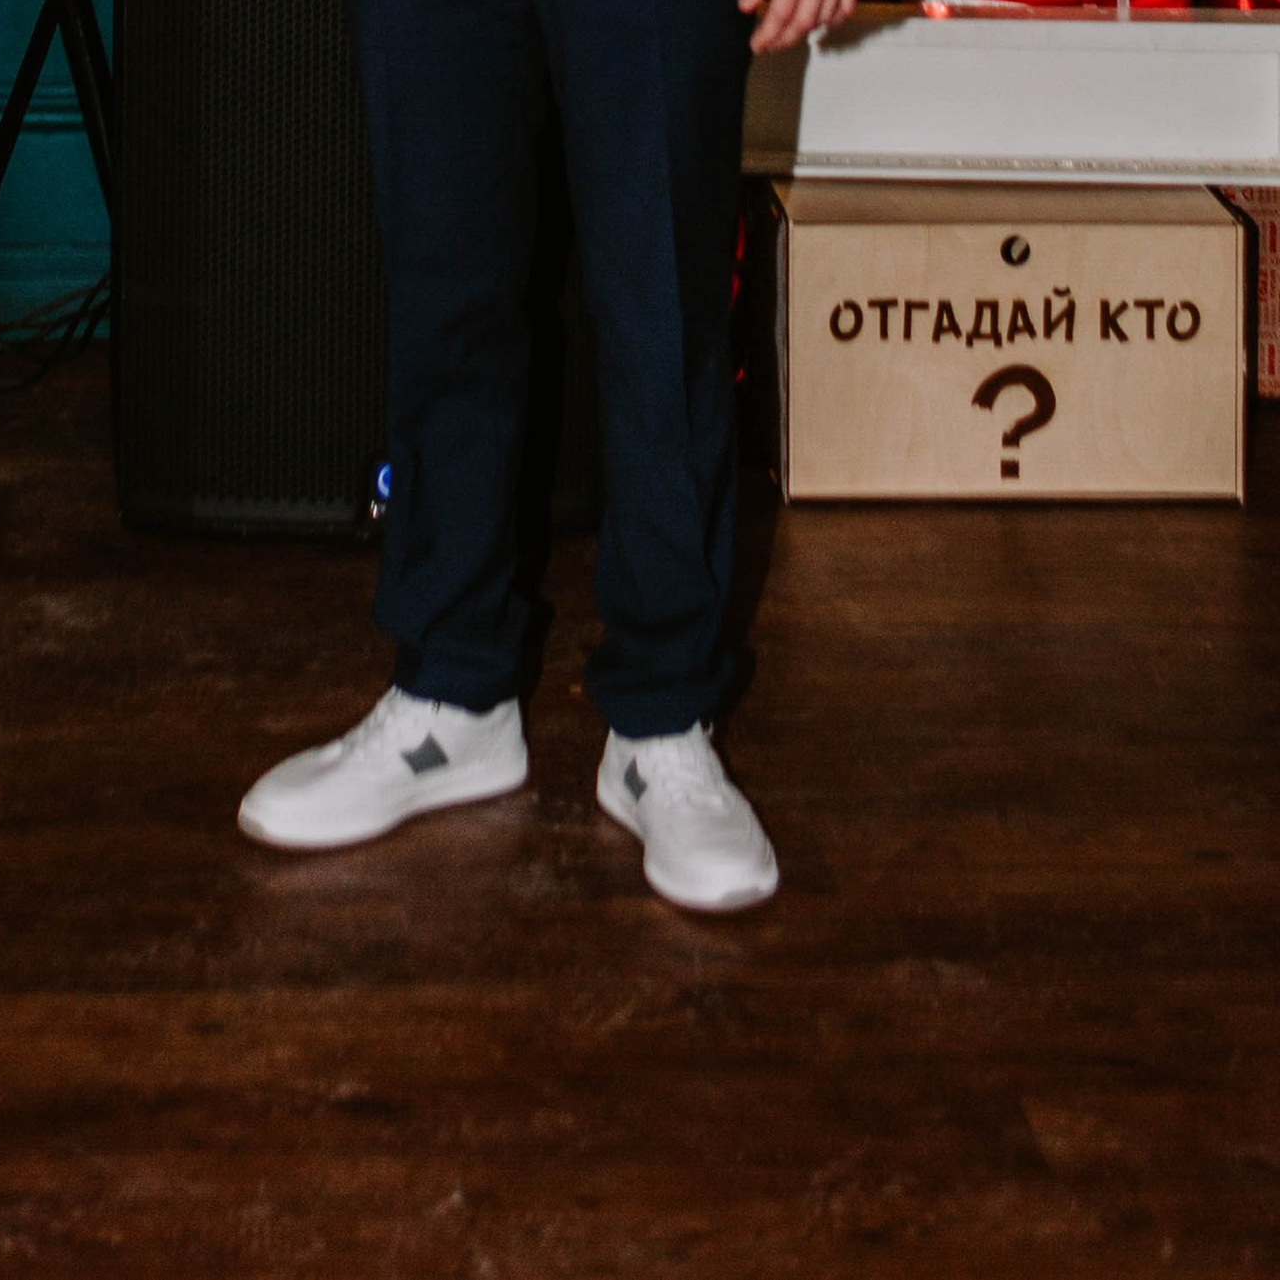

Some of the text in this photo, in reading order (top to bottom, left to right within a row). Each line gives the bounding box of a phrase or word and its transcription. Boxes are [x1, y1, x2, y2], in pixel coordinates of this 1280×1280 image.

[829, 285, 1201, 348] ОТГАДАЙ КТО
[971, 363, 1057, 479] ?
